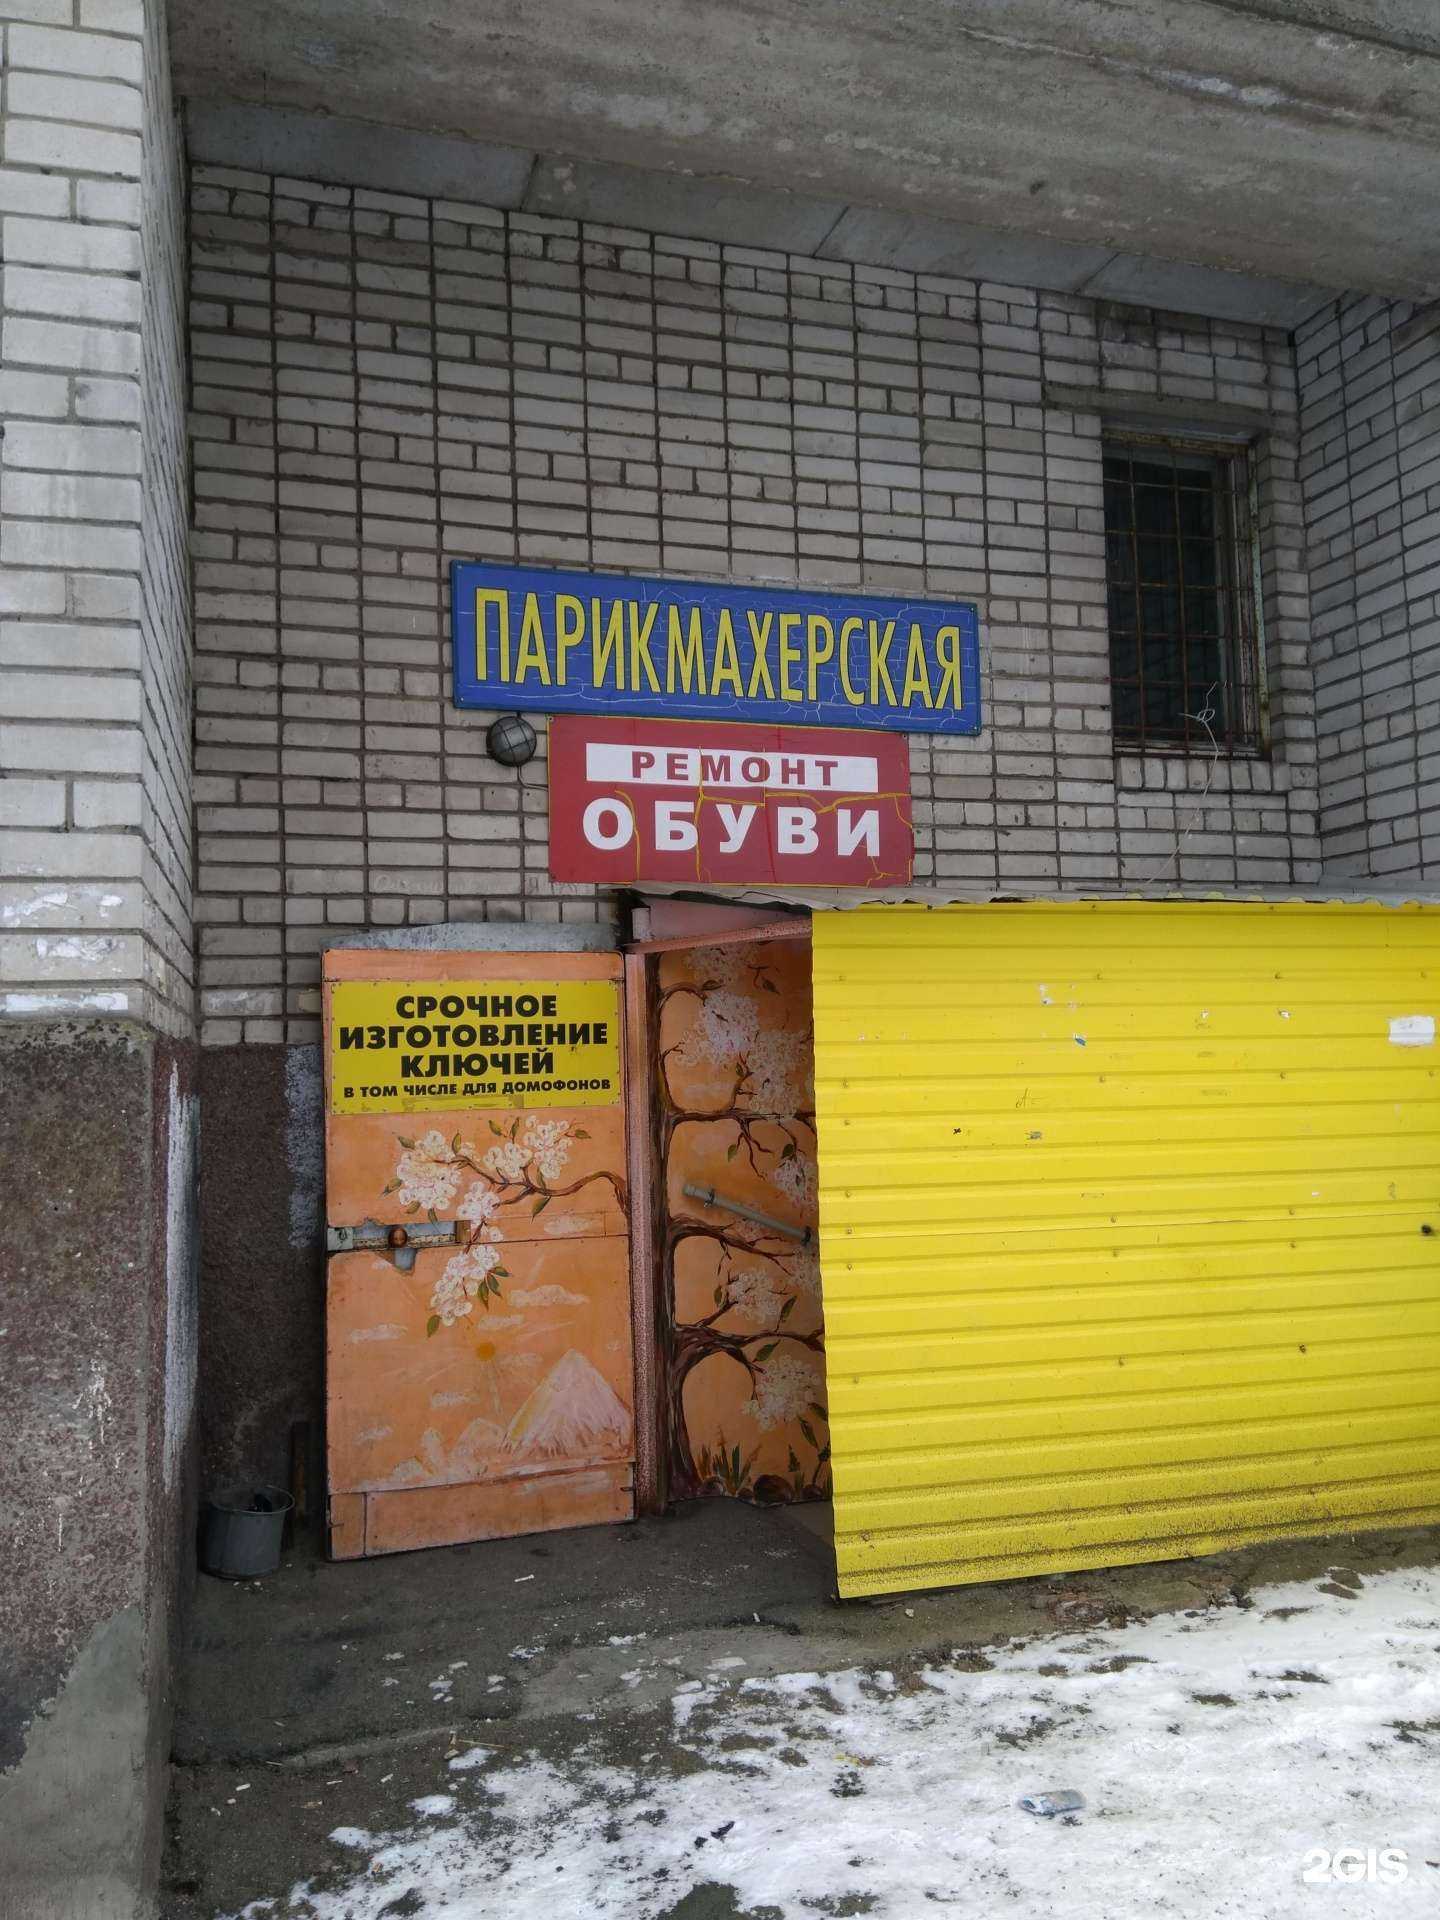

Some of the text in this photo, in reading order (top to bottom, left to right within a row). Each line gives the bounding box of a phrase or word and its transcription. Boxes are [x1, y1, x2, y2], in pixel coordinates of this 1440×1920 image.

[475, 586, 963, 710] ПАРИКМАХЕРСКАЯ
[631, 750, 839, 786] РЕМОНТ
[582, 797, 880, 857] ОБУВИ
[396, 994, 557, 1018] СРОЧНОЕ
[339, 1022, 608, 1049] ИЗГОТОВЛЕНИЕ
[400, 1047, 554, 1077] КЛЮЧЕЙ
[343, 1079, 611, 1098] В ТОМ ЧИСЛЕ ДЛЯ ДОМОФОНОВ
